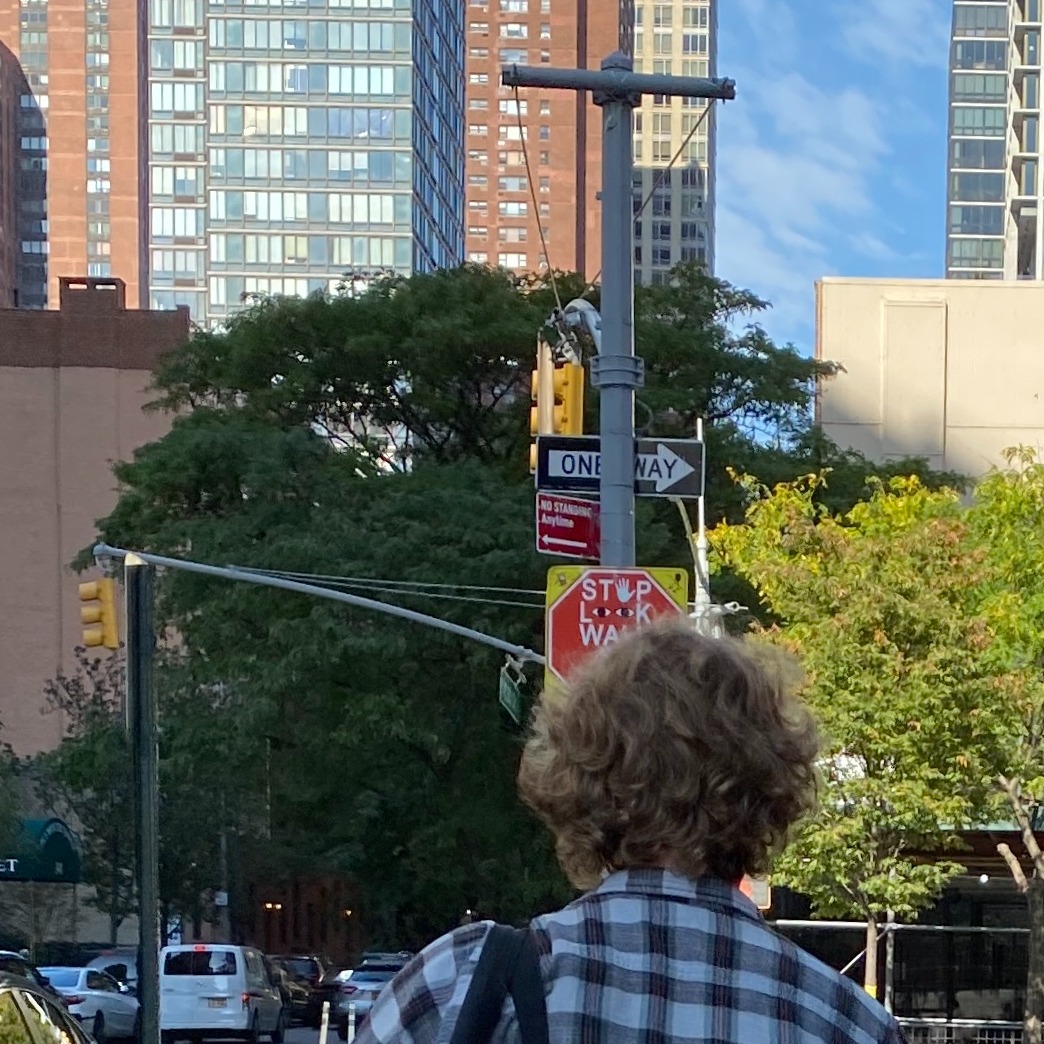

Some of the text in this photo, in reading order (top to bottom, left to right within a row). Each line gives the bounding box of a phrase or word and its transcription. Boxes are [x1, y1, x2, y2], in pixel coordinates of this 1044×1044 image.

[541, 500, 593, 518] NO STANDING
[541, 513, 575, 528] Anytime
[581, 578, 653, 601] STP
[579, 623, 642, 646] WA
